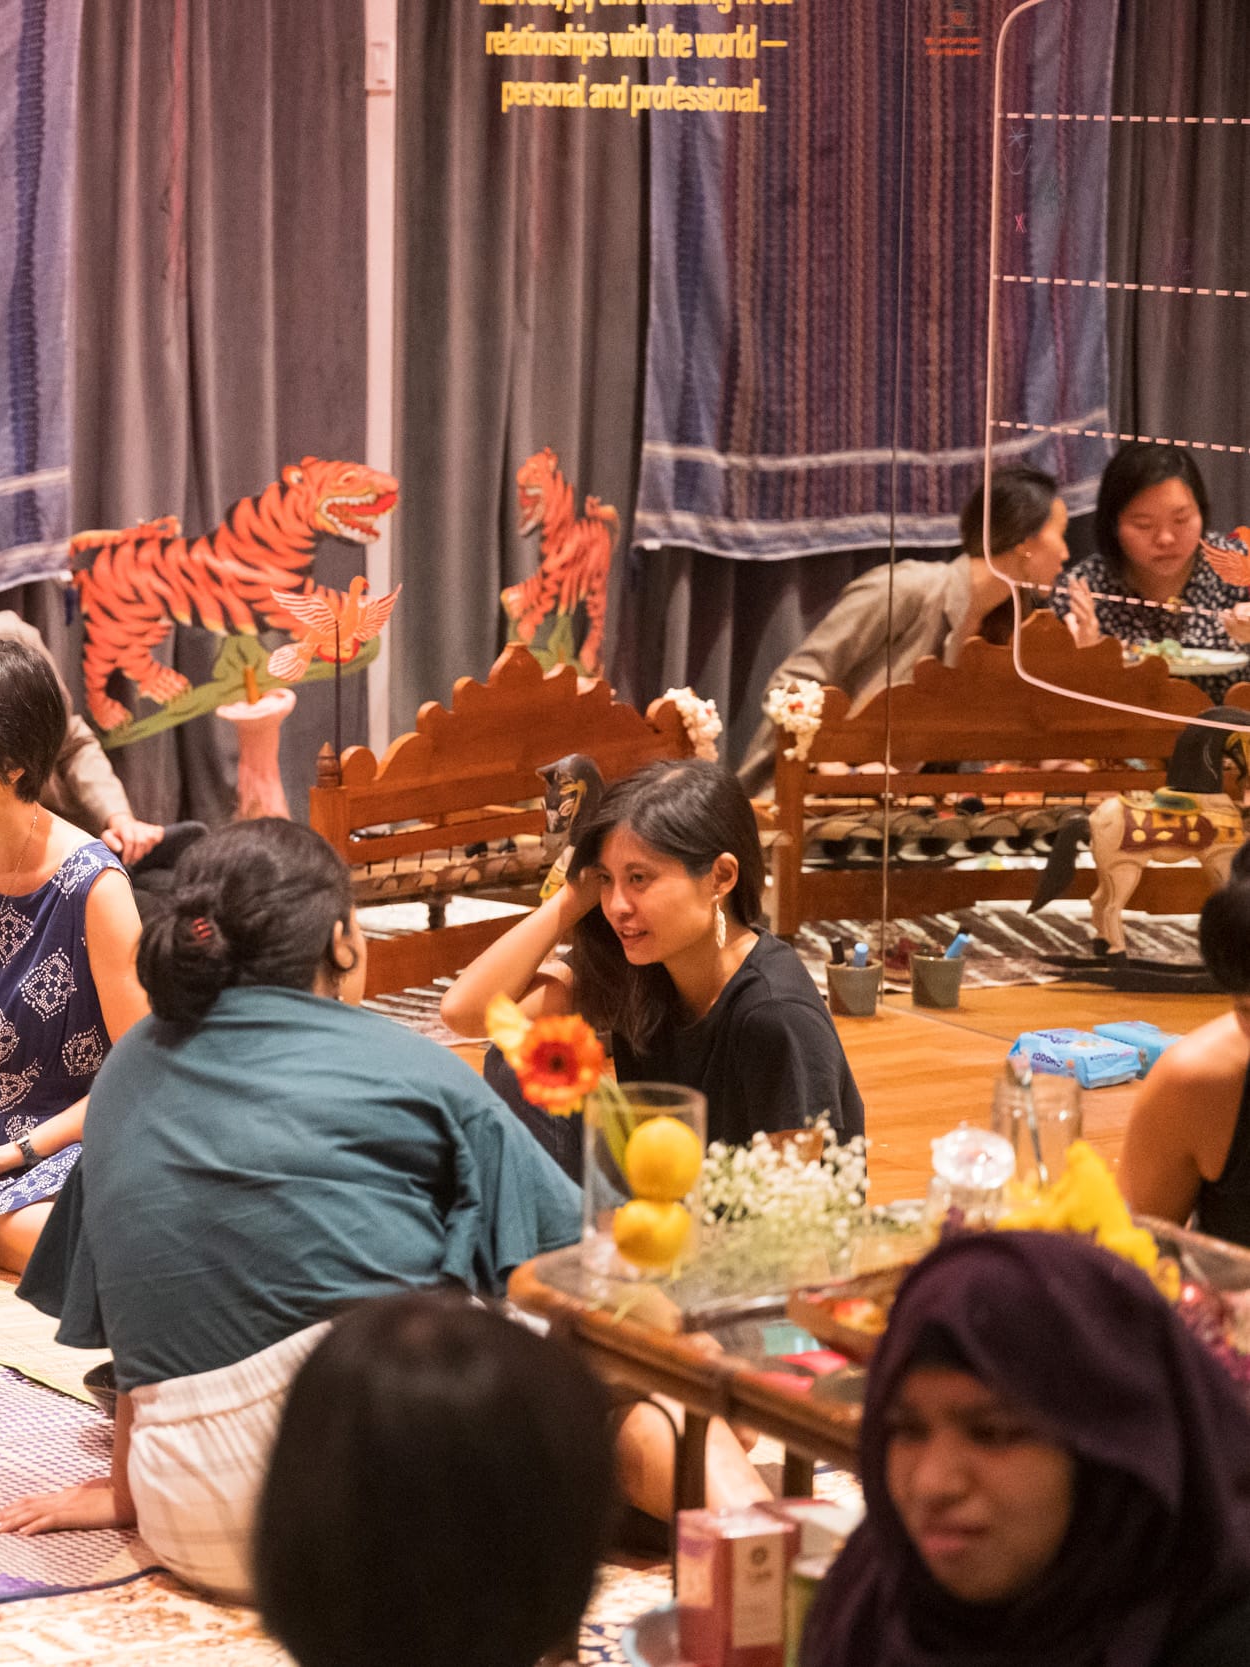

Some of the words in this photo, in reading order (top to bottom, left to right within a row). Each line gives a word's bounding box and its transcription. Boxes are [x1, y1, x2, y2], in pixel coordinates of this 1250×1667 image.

[486, 23, 608, 64] relationships
[609, 24, 655, 57] with
[657, 24, 693, 58] the
[695, 24, 758, 58] world
[502, 75, 587, 113] personal
[589, 76, 628, 109] and
[631, 77, 766, 117] professional.
